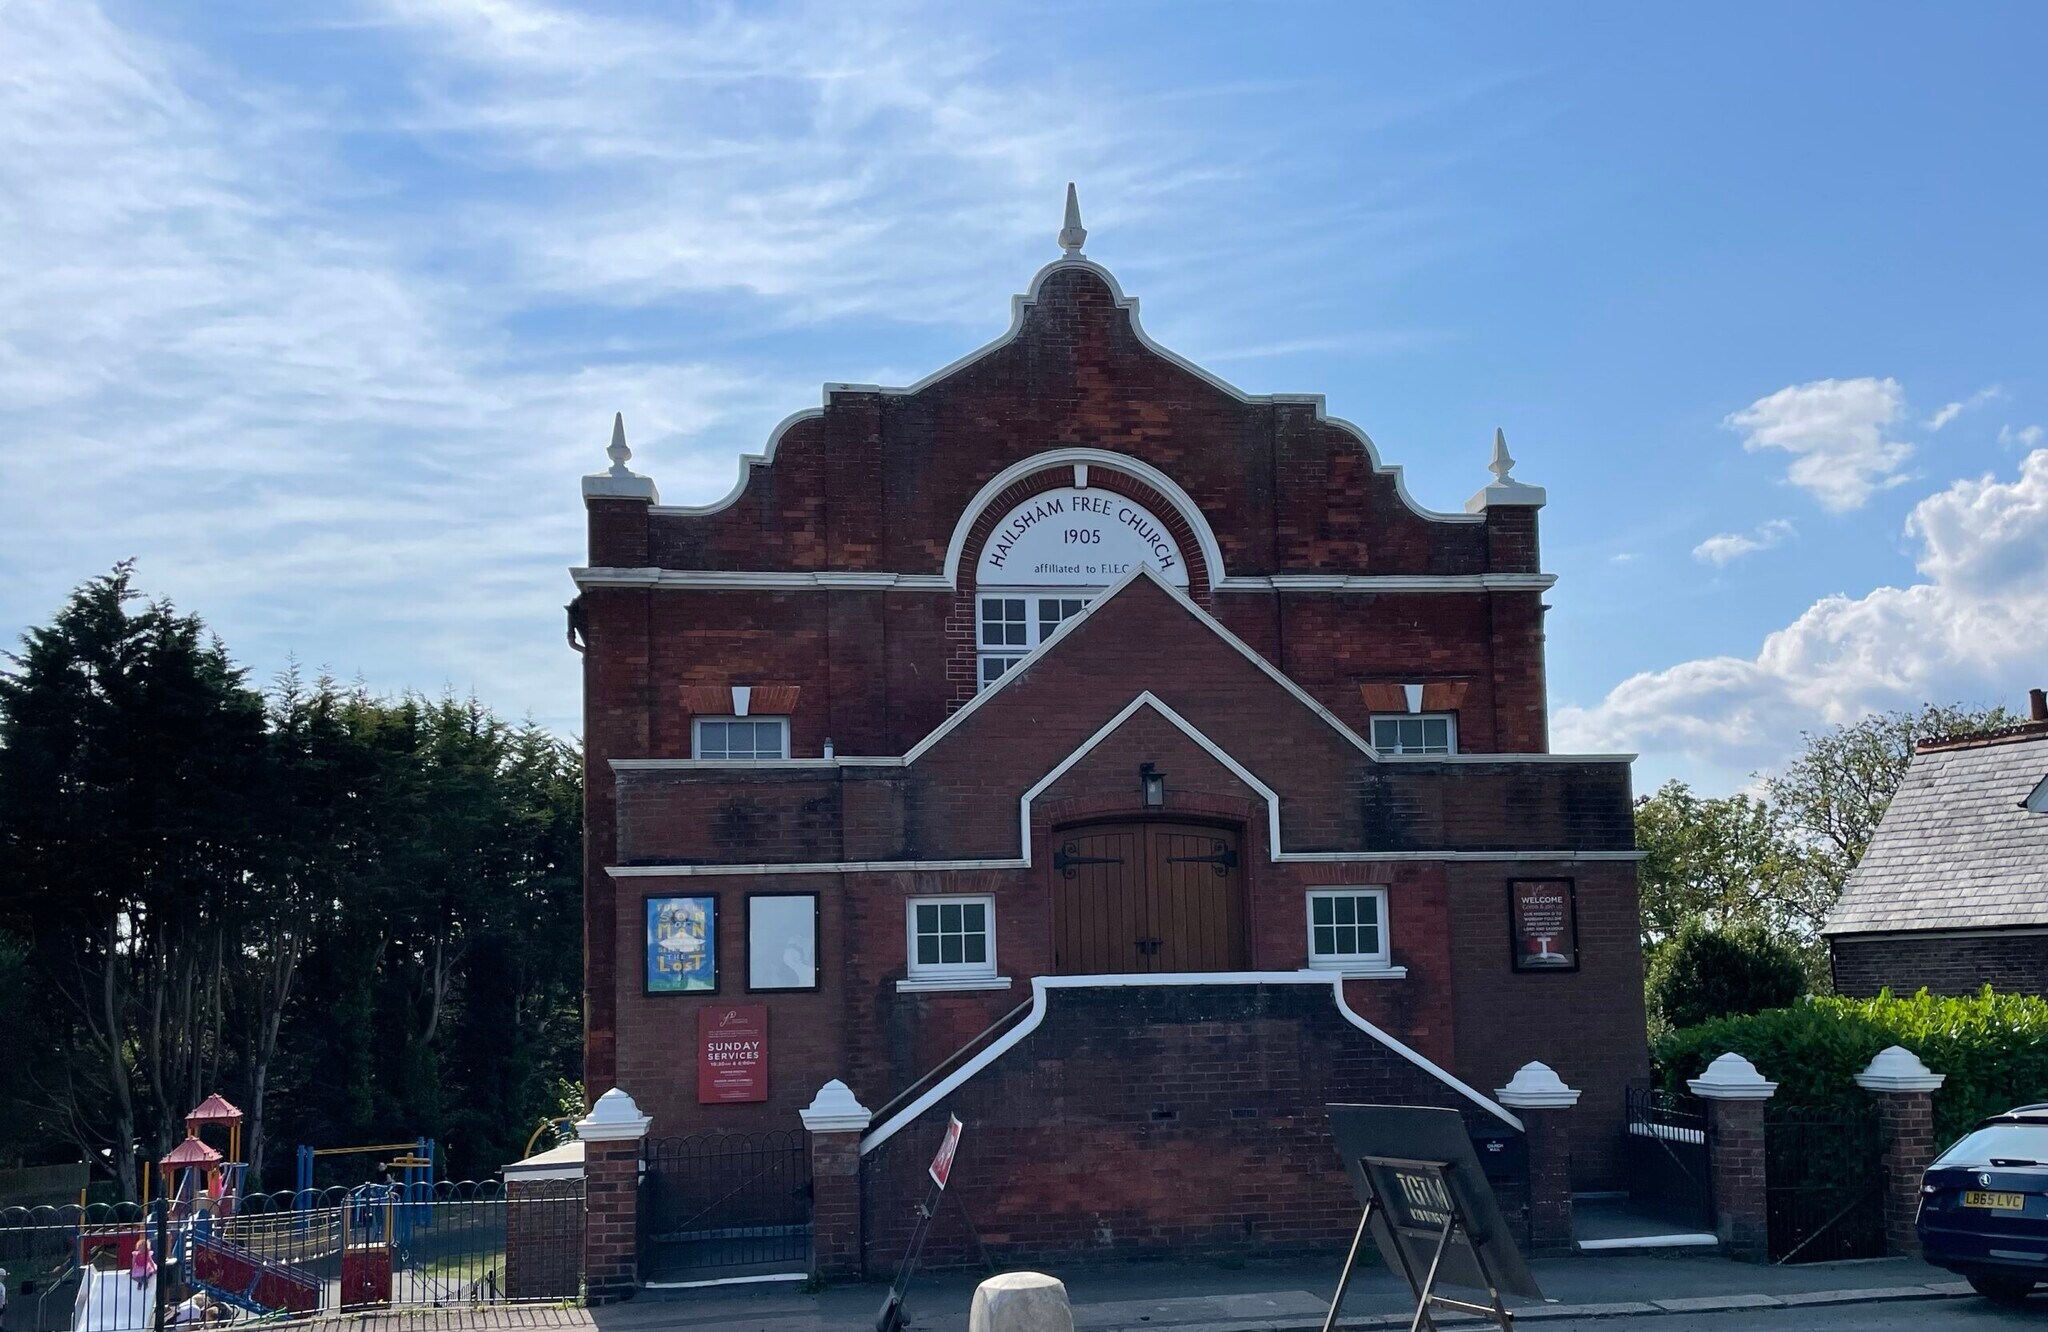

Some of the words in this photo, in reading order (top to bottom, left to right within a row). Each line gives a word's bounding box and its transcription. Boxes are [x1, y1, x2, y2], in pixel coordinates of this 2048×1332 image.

[989, 498, 1064, 569] HAILSHAM
[1072, 496, 1113, 516] FREE
[1118, 508, 1175, 569] CHURCH
[1063, 529, 1101, 544] 1905
[1034, 563, 1080, 574] affiliated
[1086, 564, 1096, 574] to
[1521, 896, 1563, 904] WELCOME
[657, 922, 705, 939] MAN
[667, 953, 686, 961] THE
[708, 1041, 760, 1052] SUNDAY
[707, 1051, 760, 1060] SERVICES
[1965, 1193, 1995, 1206] LB65
[1996, 1194, 2021, 1207] LVC
